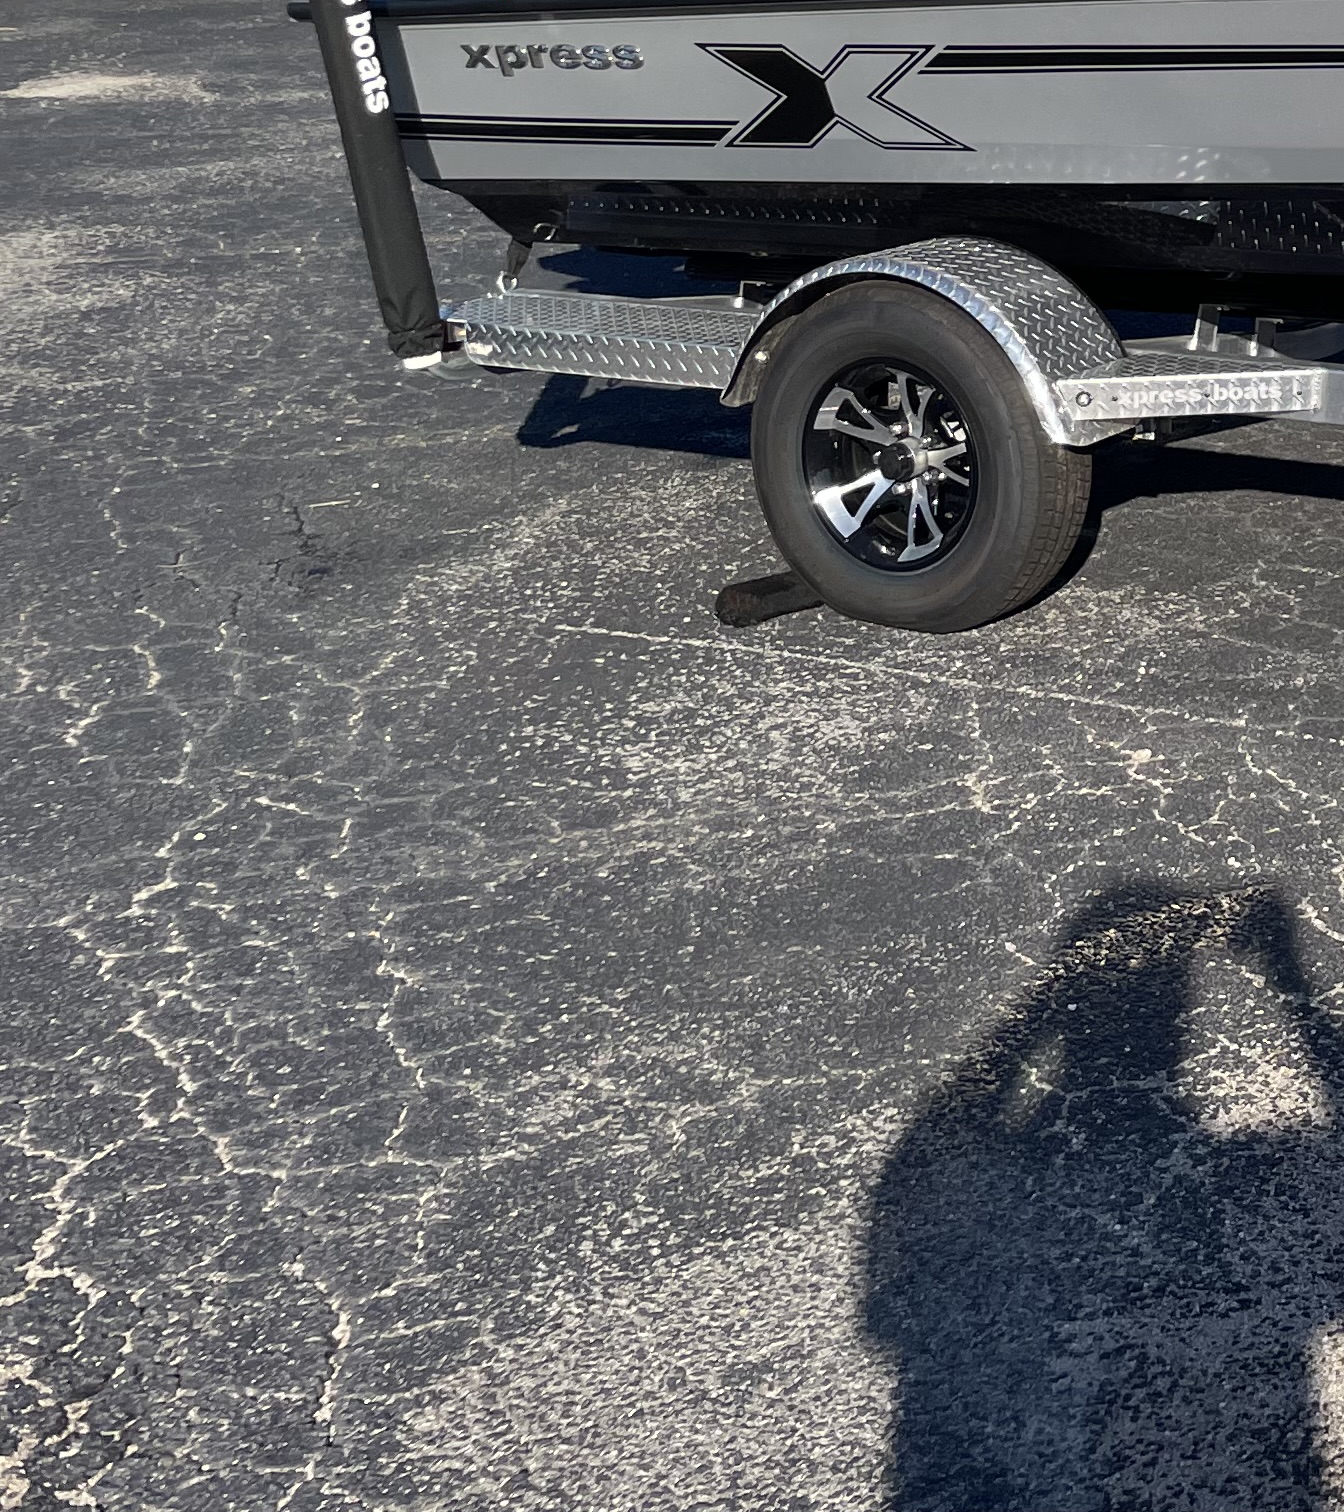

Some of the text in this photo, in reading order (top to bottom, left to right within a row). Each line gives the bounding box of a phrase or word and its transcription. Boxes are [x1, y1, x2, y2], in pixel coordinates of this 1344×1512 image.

[344, 10, 390, 115] boats
[460, 43, 645, 77] xpress
[1117, 381, 1283, 408] xpress boats
